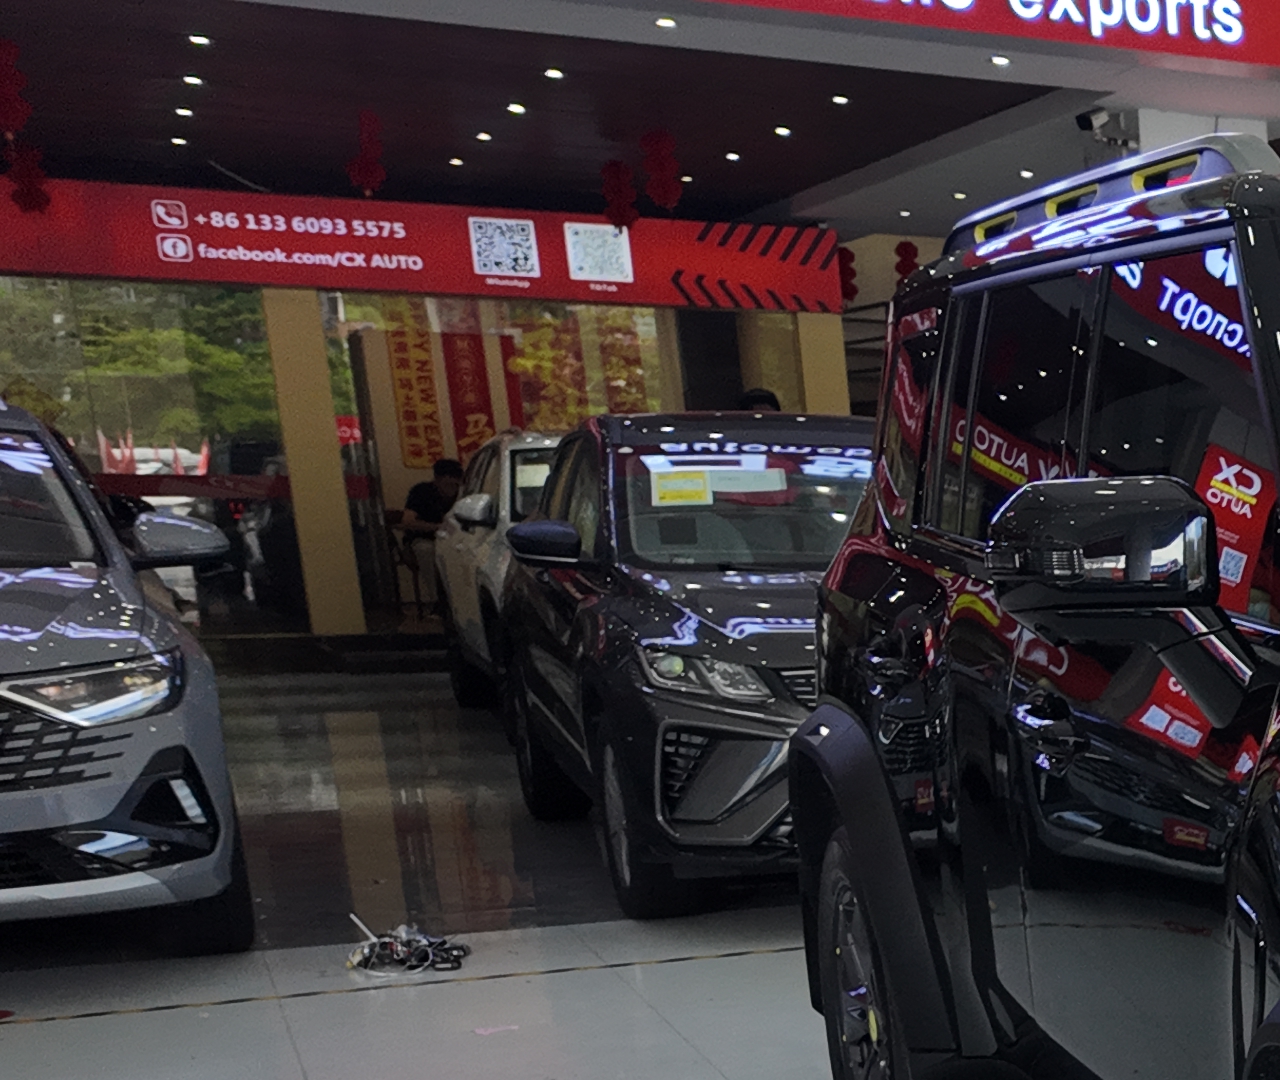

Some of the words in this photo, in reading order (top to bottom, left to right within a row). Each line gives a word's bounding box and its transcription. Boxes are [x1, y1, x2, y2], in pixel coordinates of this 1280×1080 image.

[194, 211, 239, 229] +86
[245, 213, 287, 232] 133
[291, 216, 347, 236] 6093
[352, 219, 407, 239] 5575
[198, 242, 366, 268] facebook.com/CX
[370, 254, 423, 271] AUTO
